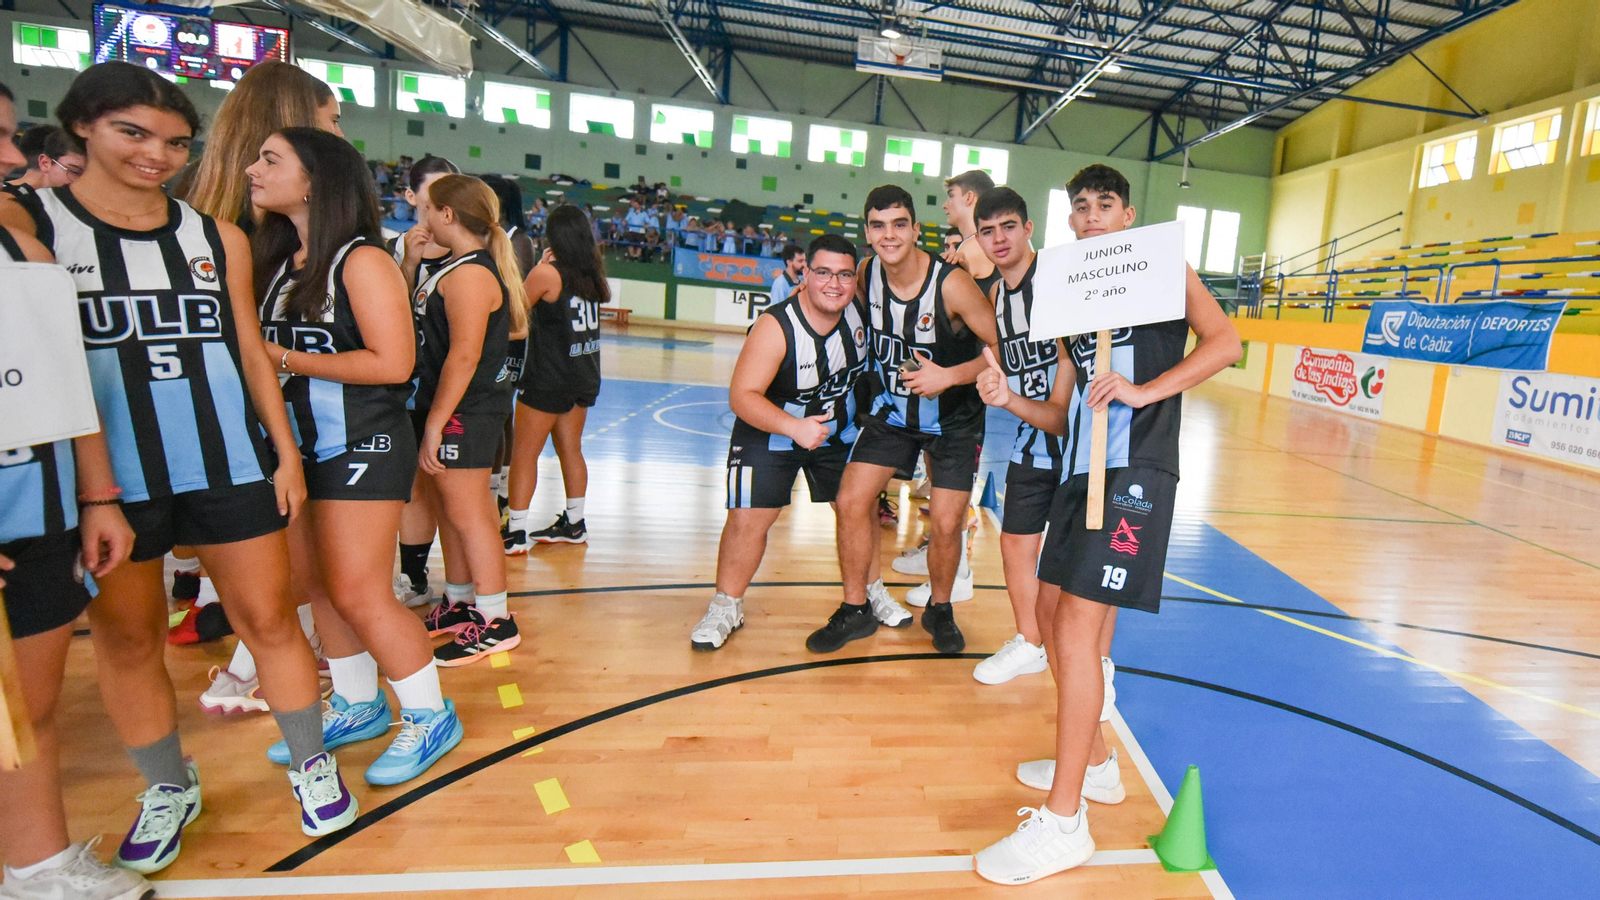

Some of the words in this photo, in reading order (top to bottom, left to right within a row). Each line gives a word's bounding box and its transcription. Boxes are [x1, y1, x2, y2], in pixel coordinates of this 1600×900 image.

[1083, 244, 1132, 261] JUNIOR
[1067, 261, 1148, 284] MASCULINO
[732, 290, 747, 304] LA
[1084, 289, 1098, 301] 2º
[1102, 286, 1127, 298] año
[77, 295, 223, 345] ULB
[570, 295, 599, 332] 30
[1408, 311, 1471, 330] Diputación
[1480, 317, 1552, 332] DEPORTES
[1404, 333, 1417, 350] de
[1420, 334, 1453, 353] Cádiz
[147, 344, 183, 380] 5
[1302, 350, 1353, 374] Compañía
[1024, 369, 1048, 397] 23
[1296, 366, 1307, 379] de
[1308, 366, 1321, 382] las
[1321, 371, 1356, 394] Indias
[1505, 410, 1590, 435] Rodamientos
[1508, 431, 1530, 441] SKF
[438, 444, 459, 460] 15
[1551, 441, 1566, 451] 956
[1568, 444, 1583, 455] 020
[346, 463, 369, 485] 7
[1101, 565, 1128, 591] 19
